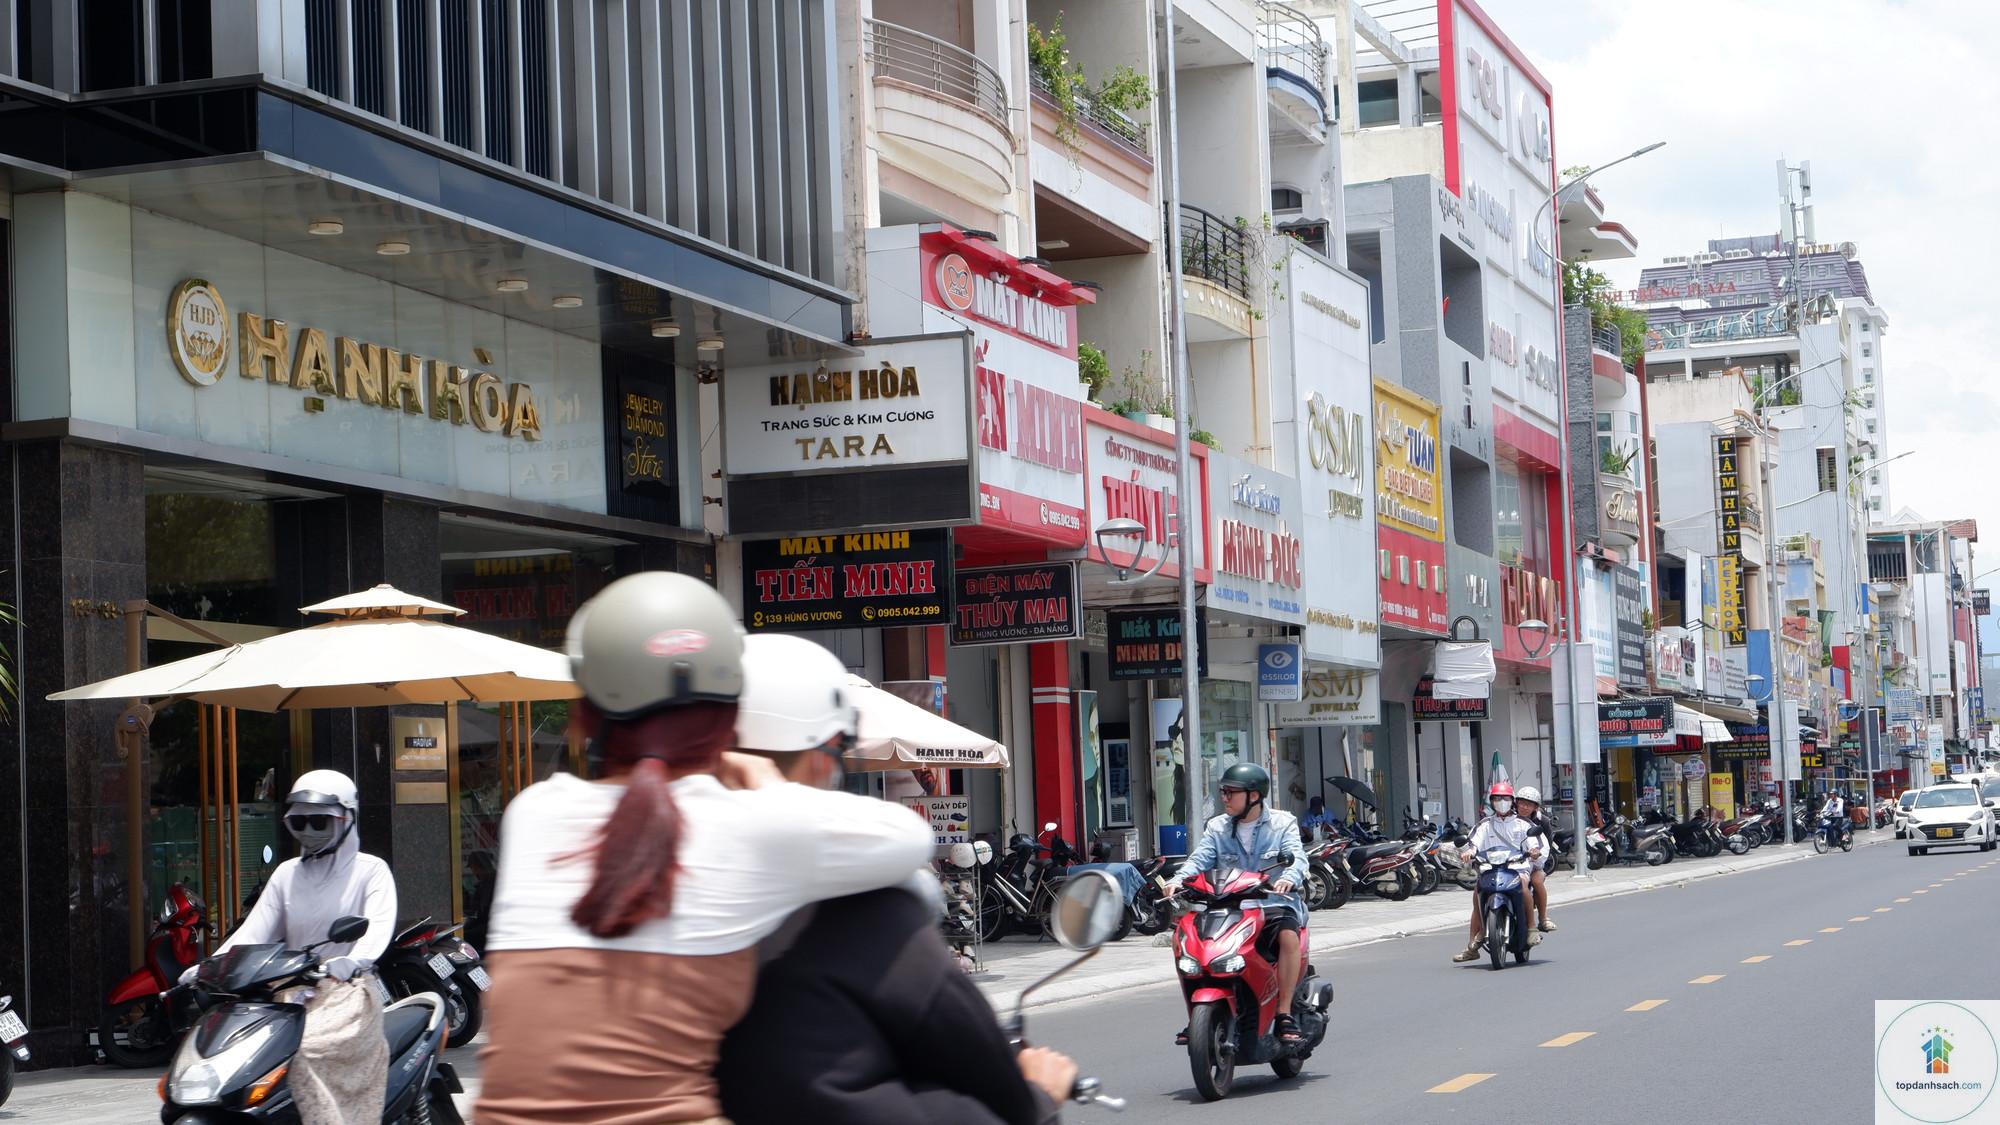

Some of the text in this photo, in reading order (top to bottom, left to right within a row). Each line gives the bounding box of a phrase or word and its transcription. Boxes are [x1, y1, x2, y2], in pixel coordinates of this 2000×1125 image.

[1467, 46, 1502, 121] TCL
[1596, 281, 1736, 301] INH TRUNG PLAZA
[975, 271, 1068, 348] MẮT KÍNH
[240, 311, 542, 441] HẠNH HÒA
[770, 361, 920, 411] HẠNH HÒA
[626, 393, 664, 416] JEWELRY
[626, 415, 665, 438] DIAMOND
[843, 415, 854, 426] &
[1009, 378, 1082, 474] MINH
[627, 436, 664, 479] Store
[795, 433, 895, 461] TARA
[756, 557, 935, 602] TIẾN MINH
[965, 571, 1056, 597] ĐIỆN MÁY
[765, 605, 940, 624] 139 HÙNG VƯƠNG 0905.042.999
[1024, 597, 1068, 624] MAI
[999, 627, 1028, 637] VƯƠNG
[1309, 702, 1360, 715] JEWELRY
[1630, 717, 1663, 731] THÀNH
[931, 801, 950, 810] GIÀY
